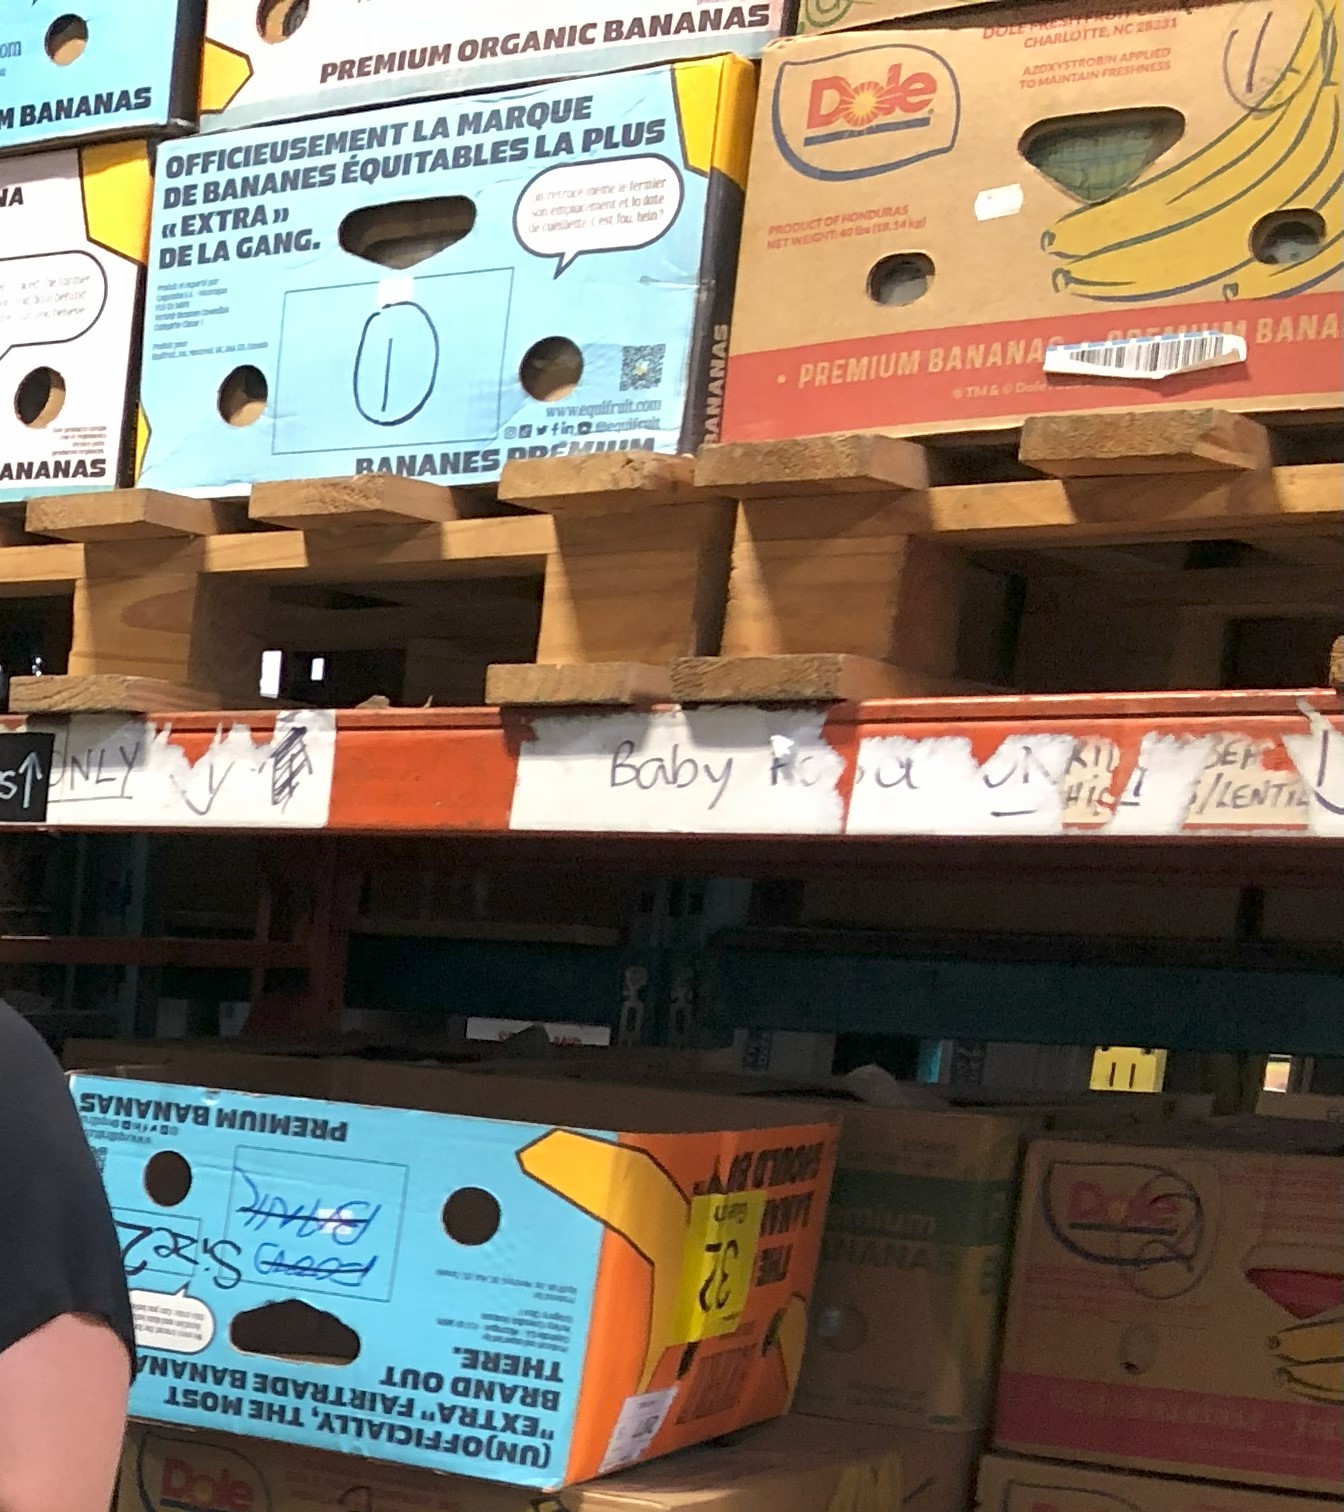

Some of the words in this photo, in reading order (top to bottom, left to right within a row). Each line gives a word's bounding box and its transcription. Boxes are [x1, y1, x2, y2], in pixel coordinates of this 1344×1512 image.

[320, 44, 451, 84] PREMIUM
[456, 22, 598, 61] ORGANIC
[602, 4, 770, 43] BANANAS
[1024, 25, 1110, 48] CHARLOTTE,
[1113, 22, 1133, 35] NC
[1020, 78, 1035, 89] TO
[1038, 71, 1099, 86] MAINTAIN
[1102, 61, 1171, 78] FRESHNESS
[1023, 54, 1117, 76] AZOXYSTROBIN
[1119, 48, 1171, 63] APPLIED
[20, 86, 151, 126] BANANAS
[806, 63, 938, 130] Dole
[165, 124, 408, 180] OFFICIEUSEMENT
[413, 113, 454, 142] LA
[457, 95, 593, 137] MARQUE
[162, 183, 200, 210] DE
[203, 161, 337, 204] BANANES
[341, 136, 530, 186] ÉQUITABLES
[534, 132, 578, 159] LA
[582, 118, 667, 152] PLUS
[768, 217, 823, 236] PRODUCT
[825, 215, 840, 228] OF
[842, 204, 909, 224] HONDURAS
[159, 246, 193, 271] DE
[197, 238, 230, 264] LA
[233, 228, 321, 260] GANG.
[767, 237, 789, 250] NET
[704, 324, 729, 445] BANANAS
[799, 346, 920, 389] PREMIUM
[546, 397, 662, 419] www.equifruit.com
[356, 449, 500, 478] BANANES
[611, 739, 733, 810] Baby
[79, 1091, 210, 1128] BANANAS
[216, 1108, 348, 1143] PREMIUM
[153, 1226, 242, 1290] Size
[136, 1355, 247, 1389] BANANA
[380, 1365, 443, 1394] OUT
[453, 1346, 563, 1384] THERE.
[165, 1386, 243, 1423] MOST
[253, 1373, 414, 1418] FAIRTRADE
[452, 1373, 560, 1412] BRAND
[246, 1398, 304, 1428] THE
[422, 1400, 555, 1441] "EXTRA"
[311, 1405, 552, 1468] (UN)OFFICIALLY,
[162, 1457, 253, 1512] Dole
